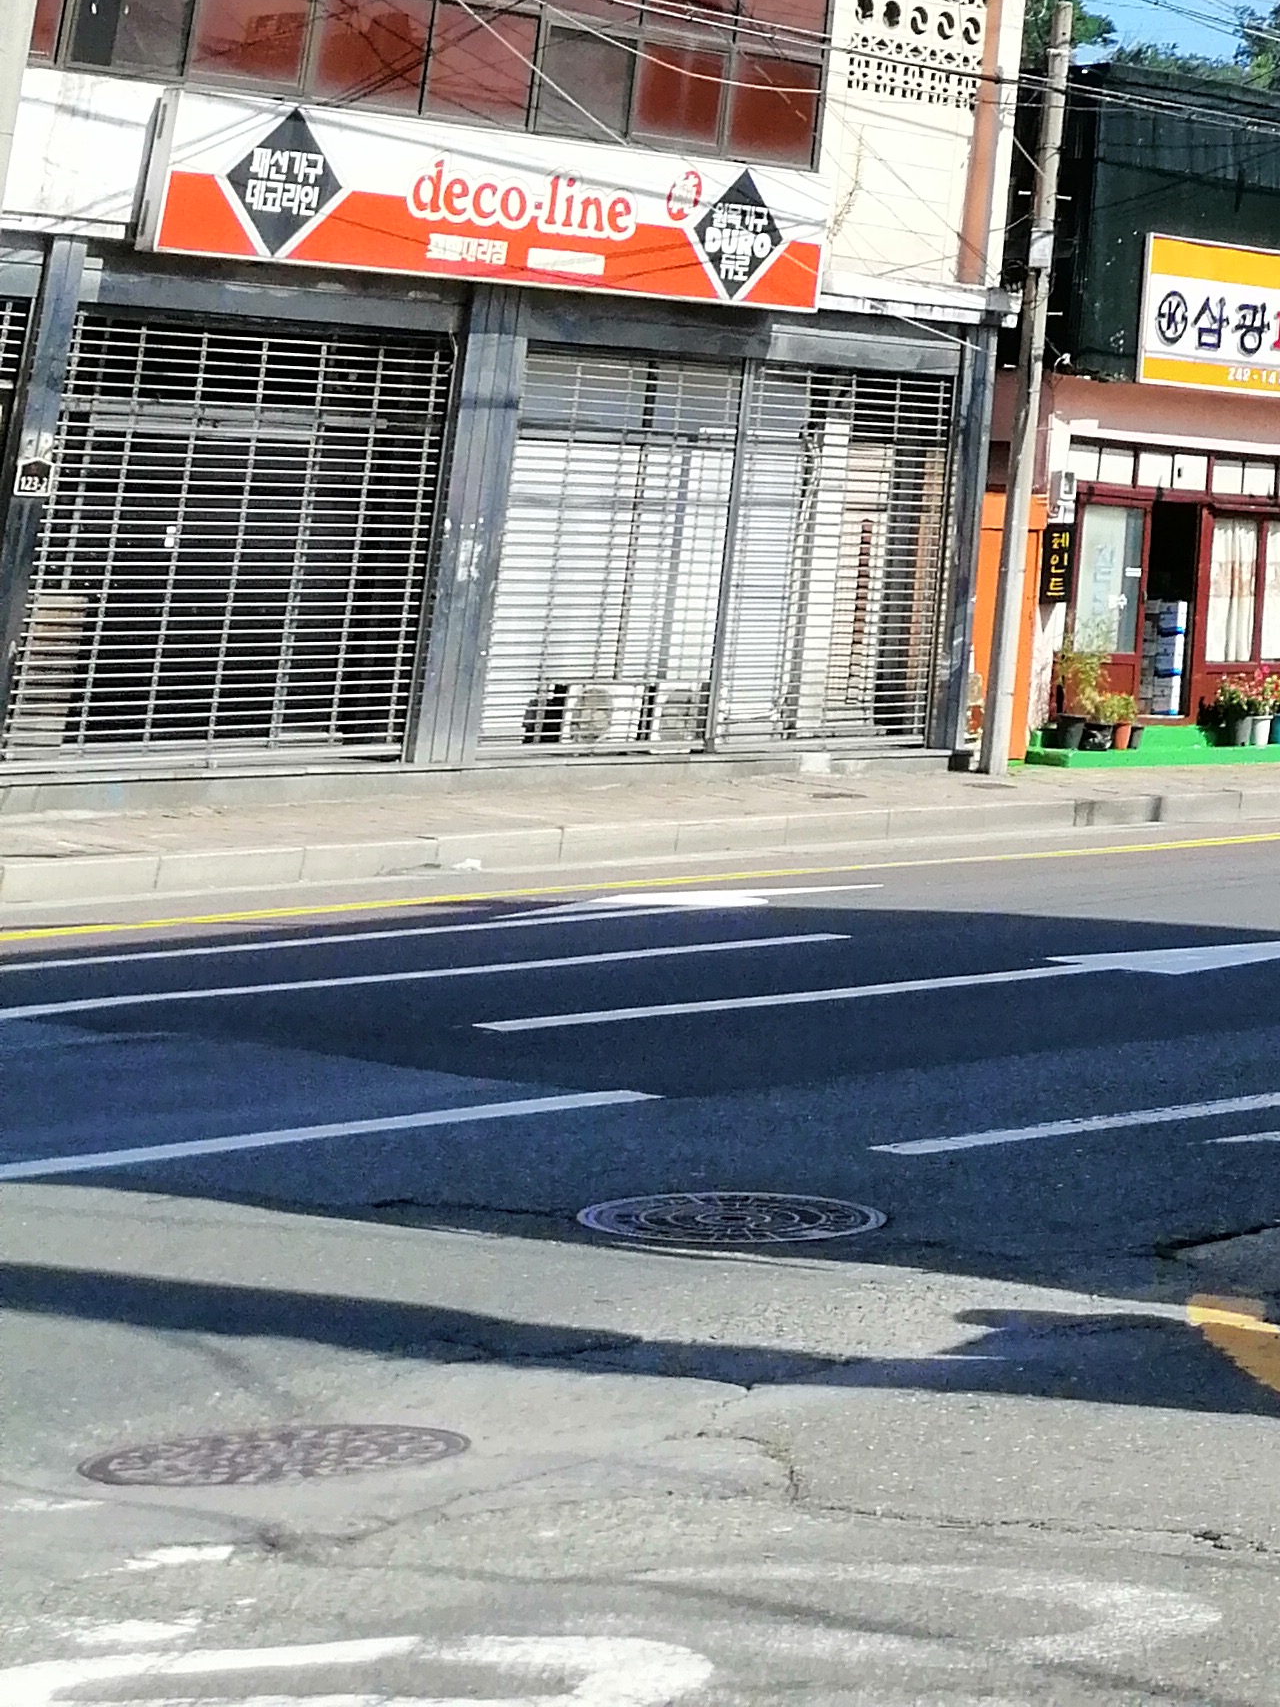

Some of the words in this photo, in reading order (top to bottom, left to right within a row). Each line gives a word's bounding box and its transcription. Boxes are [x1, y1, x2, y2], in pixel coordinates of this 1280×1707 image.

[248, 146, 325, 185] 패션가구
[411, 159, 633, 233] deco-line
[704, 226, 773, 259] DURO
[719, 253, 752, 282] 듀로
[1046, 531, 1070, 596] 페인트
